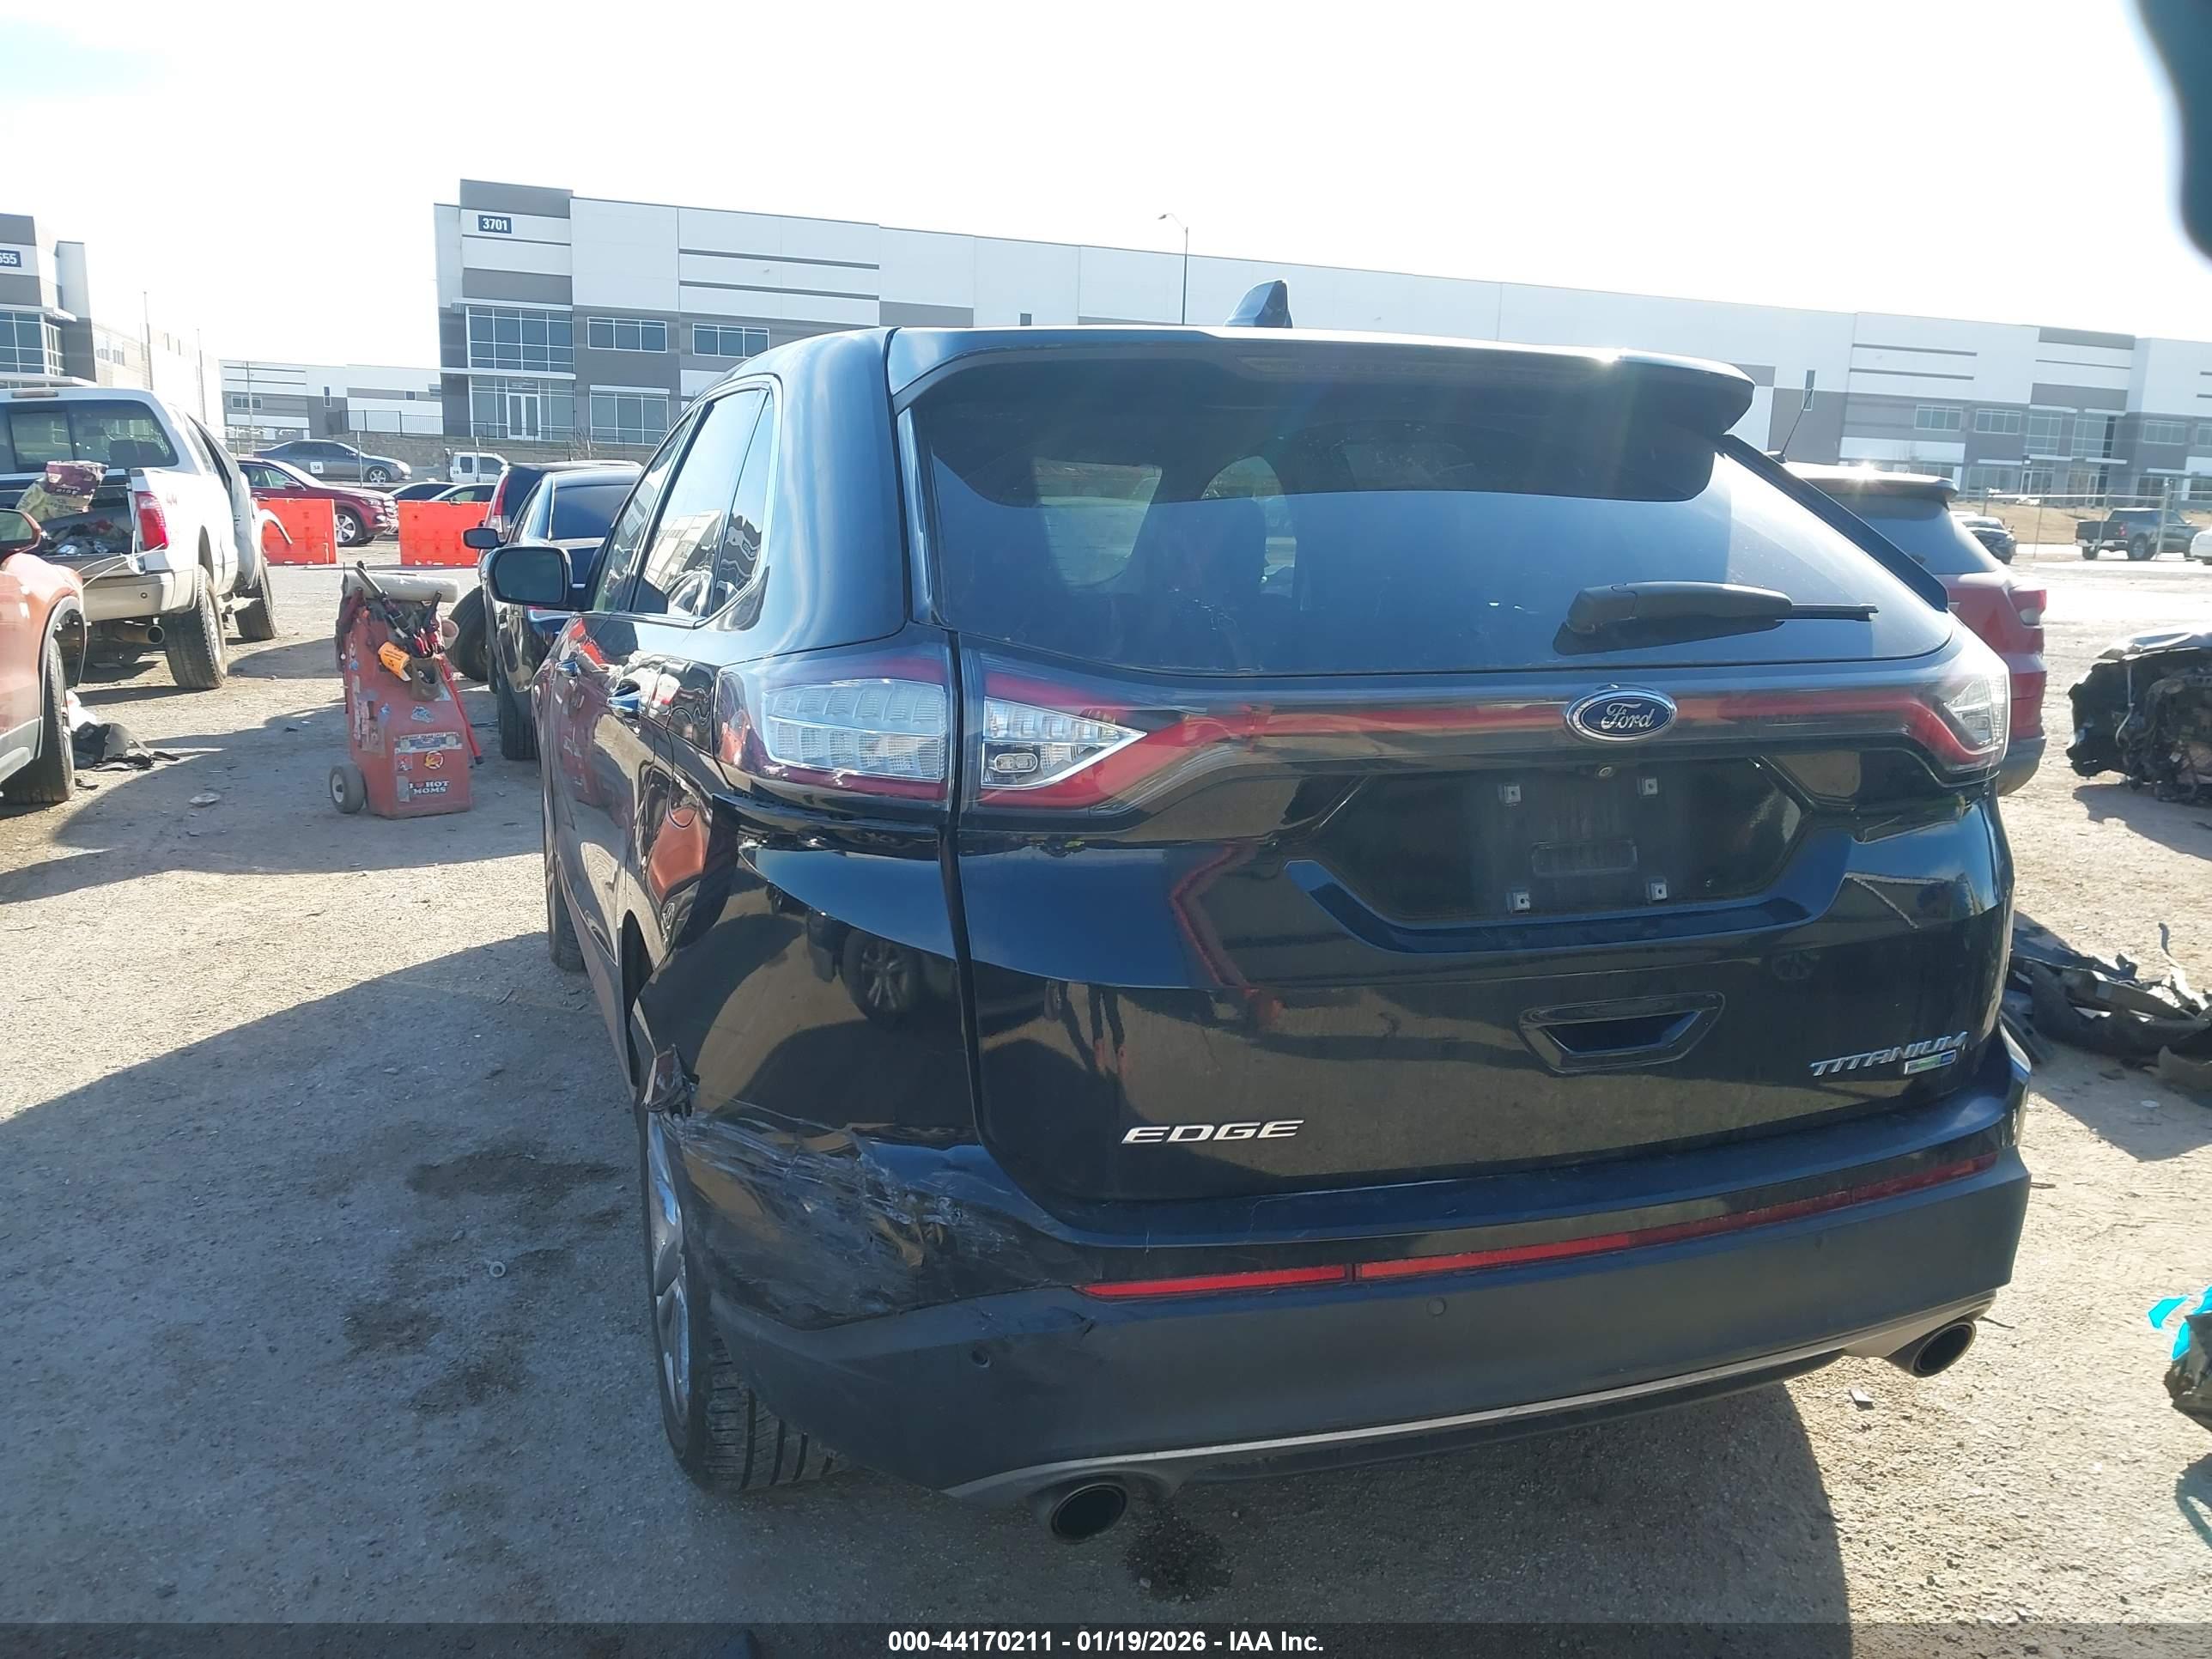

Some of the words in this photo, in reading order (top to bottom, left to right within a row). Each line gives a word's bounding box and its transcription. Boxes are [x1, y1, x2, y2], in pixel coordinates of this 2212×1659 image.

[482, 217, 508, 231] 3701
[1601, 702, 1655, 729] Ford
[412, 787, 447, 795] MOMS
[425, 780, 449, 788] HOT
[1809, 1030, 1968, 1077] TITANIUM
[1121, 1120, 1304, 1145] EDGE
